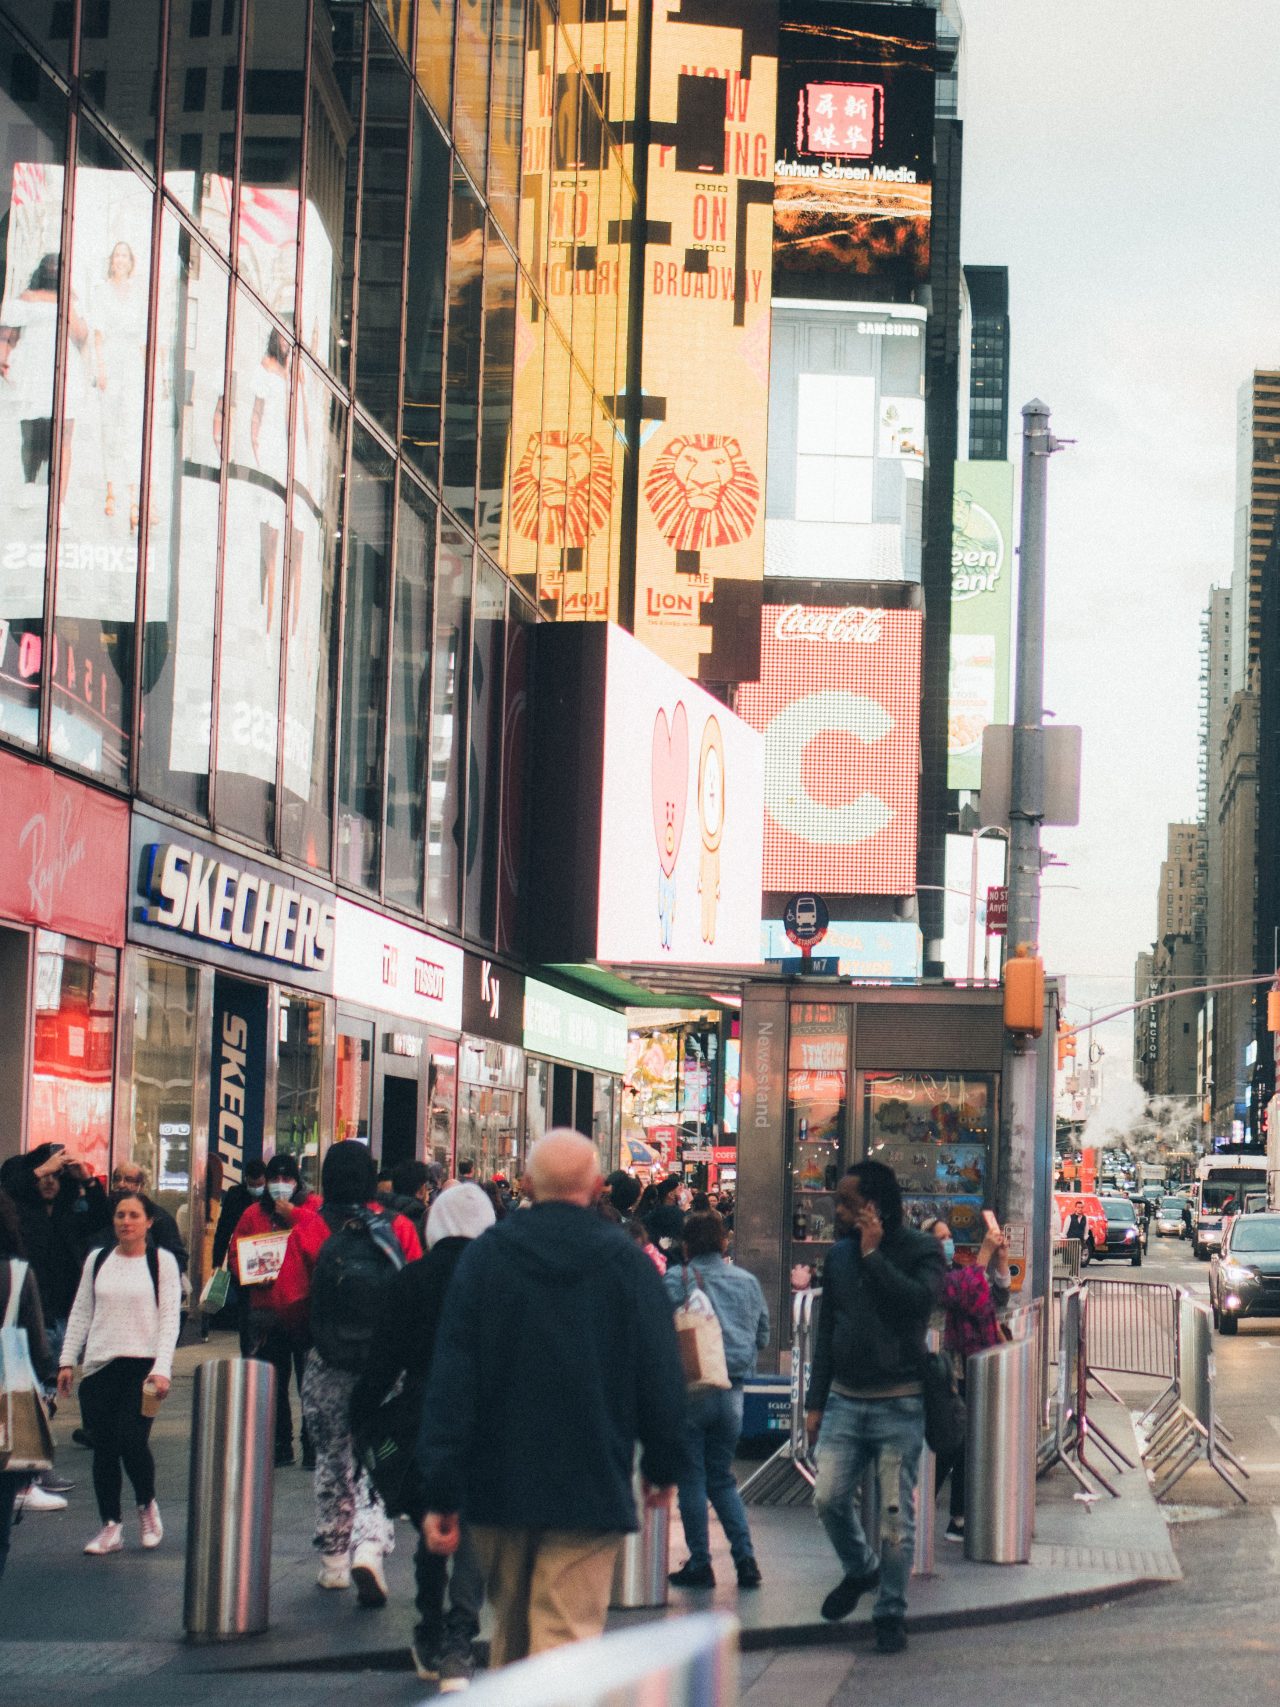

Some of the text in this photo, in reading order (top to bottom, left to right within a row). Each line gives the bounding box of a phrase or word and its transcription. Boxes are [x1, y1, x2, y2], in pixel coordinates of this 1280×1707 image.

[821, 161, 870, 181] Screen
[872, 165, 917, 184] Media
[692, 194, 728, 242] ON
[857, 322, 920, 337] SAMSUNG
[646, 587, 693, 617] LION
[774, 603, 888, 644] Coca-Cola
[155, 843, 337, 972] SKECHERS
[989, 891, 999, 900] NO
[989, 902, 1008, 914] Anyti
[414, 956, 445, 1002] TISSOT
[812, 957, 828, 972] M7
[1149, 983, 1159, 1059] WELINGTON
[754, 1021, 774, 1129] Newsstand
[218, 1011, 248, 1192] SKECH
